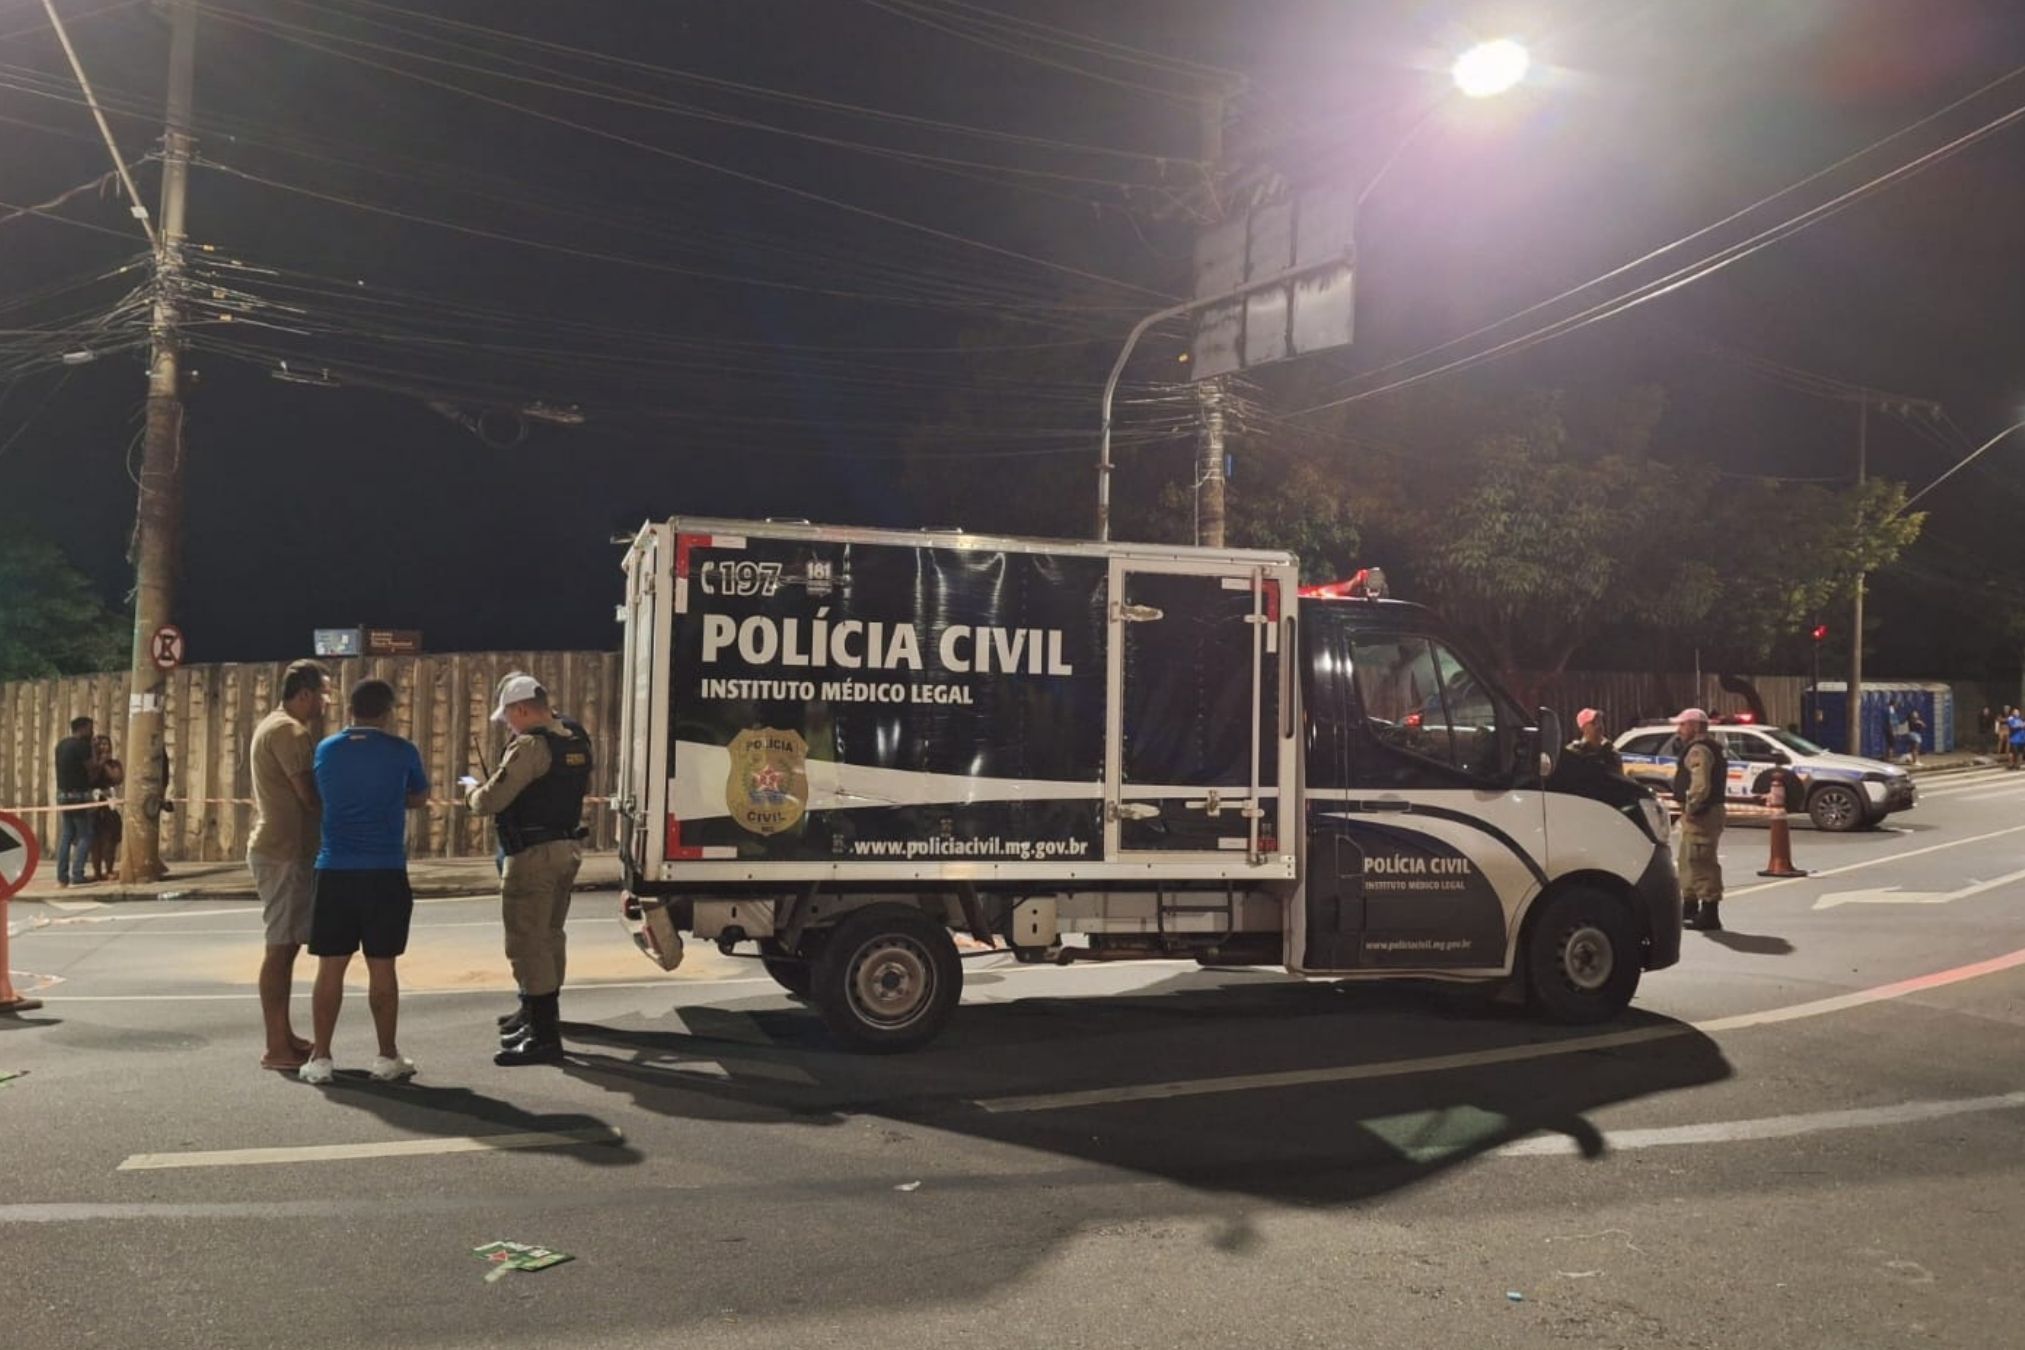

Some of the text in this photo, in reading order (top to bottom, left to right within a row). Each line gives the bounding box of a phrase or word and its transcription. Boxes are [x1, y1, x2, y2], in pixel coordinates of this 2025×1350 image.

[720, 561, 782, 596] 197
[806, 562, 832, 579] 181
[703, 608, 1073, 676] POLÍCIA CIVIL
[701, 677, 973, 704] INSTITUTO MÉDICO LEGAL
[746, 736, 794, 753] POLÍCIA
[746, 811, 787, 823] CIVIL
[854, 836, 1088, 861] www.policiacivil.mg.gov.br
[1364, 854, 1471, 874] POLÍCIA CIVIL
[1365, 880, 1465, 890] INSTITUTO MÉDICO LEGAL
